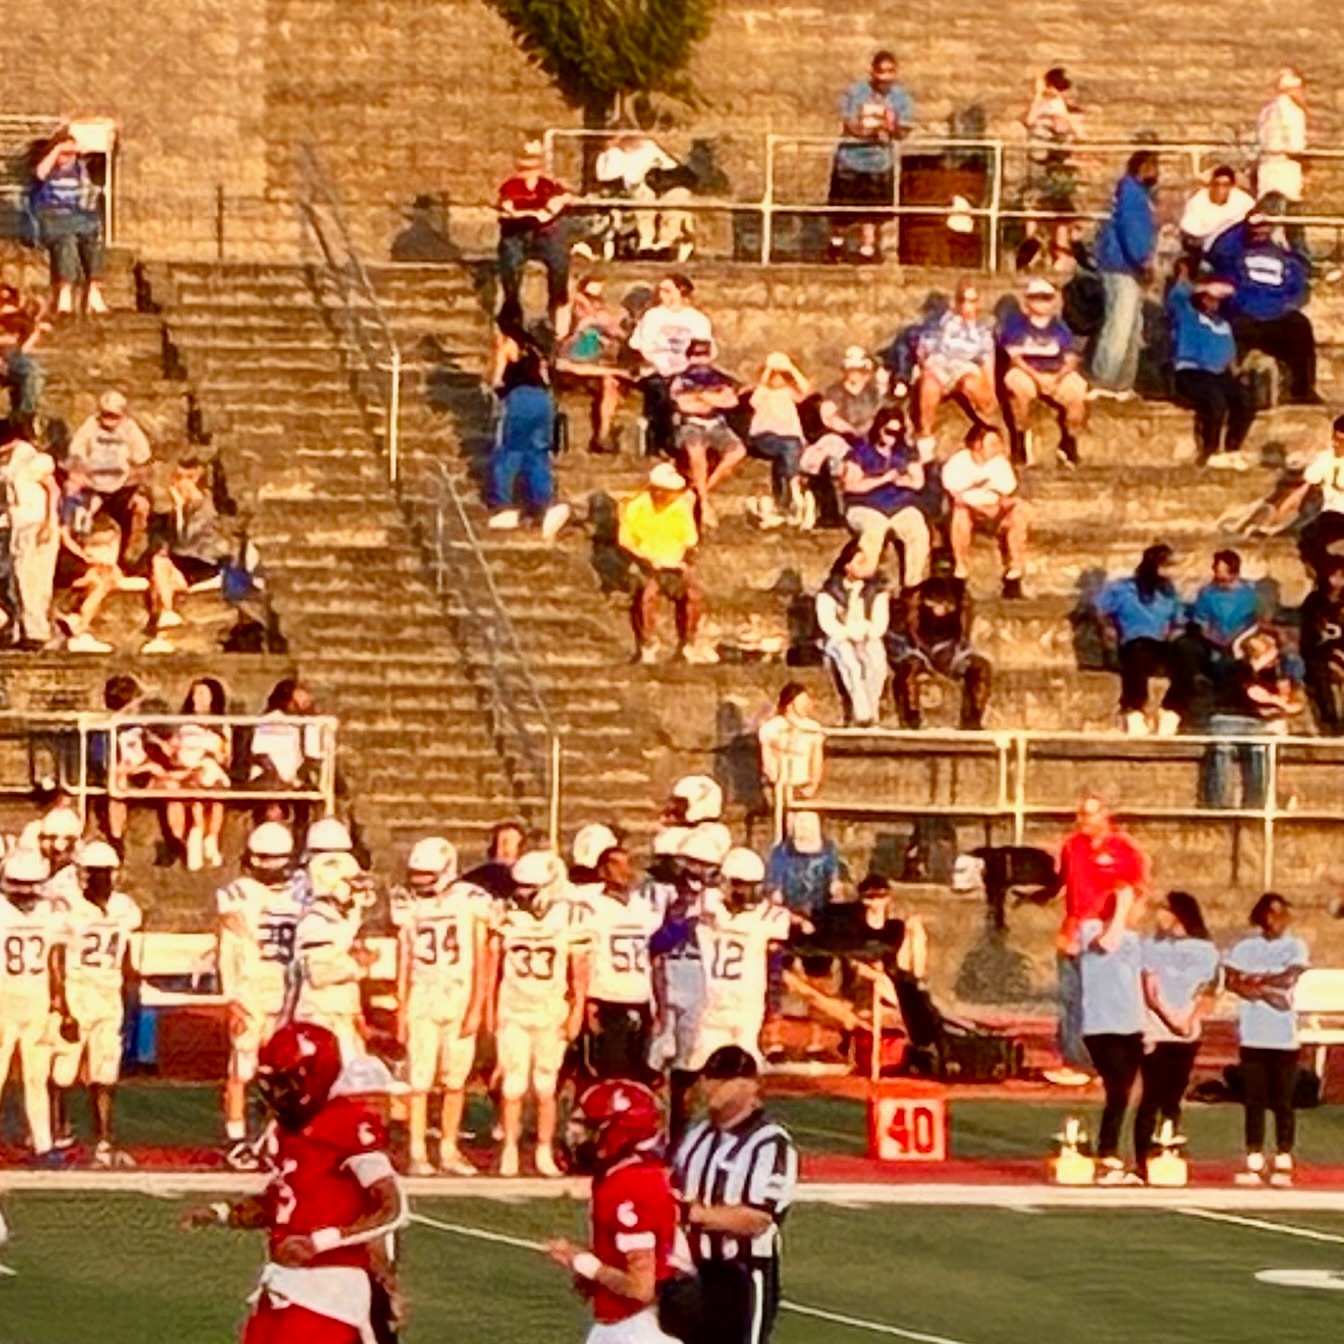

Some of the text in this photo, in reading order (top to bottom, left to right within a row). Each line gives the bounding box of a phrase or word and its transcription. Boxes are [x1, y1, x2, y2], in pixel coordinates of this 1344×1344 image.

[710, 939, 746, 981] 12
[886, 1106, 933, 1155] 40
[616, 1200, 639, 1228] 6
